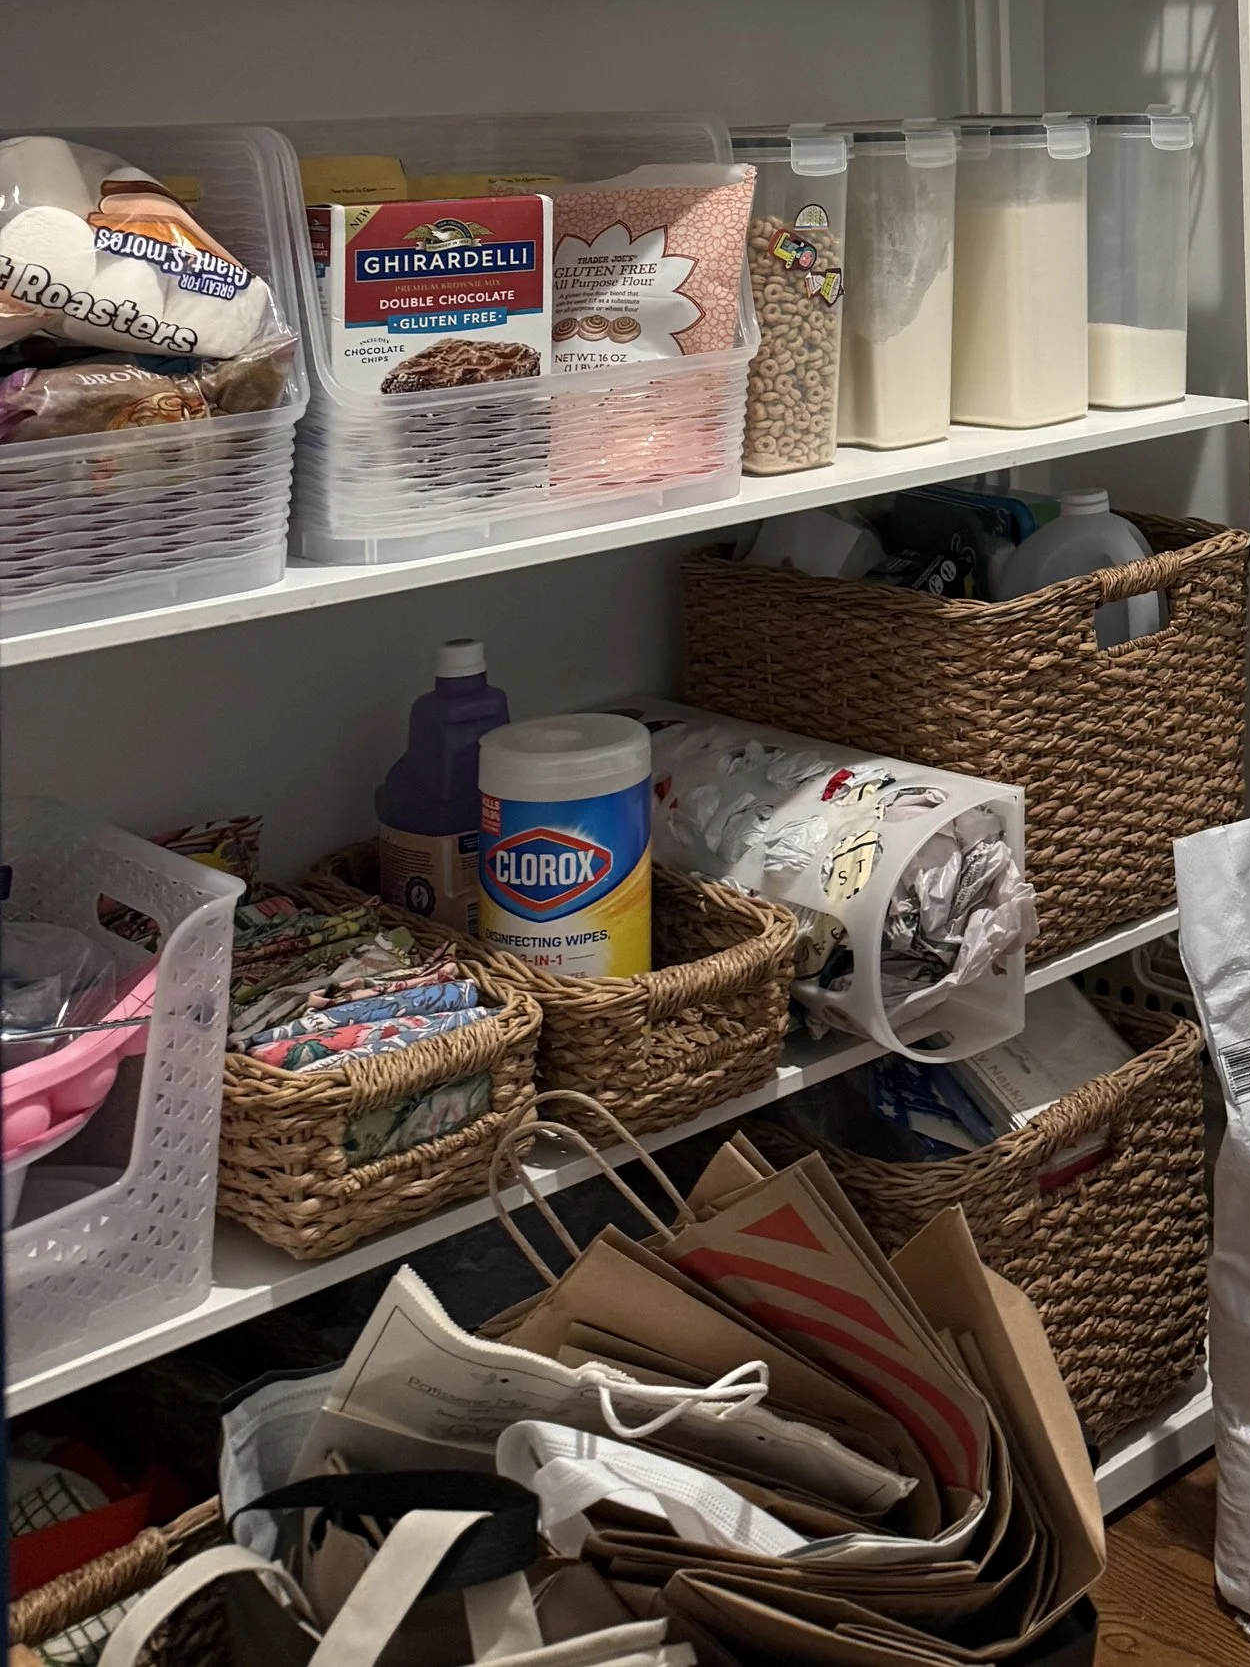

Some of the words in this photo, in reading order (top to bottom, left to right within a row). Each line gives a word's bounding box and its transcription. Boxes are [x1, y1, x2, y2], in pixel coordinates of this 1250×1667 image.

[350, 207, 371, 230] NEW
[364, 248, 527, 274] GHIRARDELLI
[554, 265, 615, 278] GLUTEN
[620, 263, 657, 275] FREE
[571, 278, 618, 290] Purpose
[622, 276, 654, 287] Flour
[12, 264, 198, 353] Roasters
[379, 295, 433, 310] DOUBLE
[439, 290, 515, 305] CHOCOLATE
[400, 314, 457, 329] GLUTEN
[464, 311, 497, 324] FREE
[344, 345, 405, 357] CHOCOLATE
[361, 355, 389, 364] CHIPS
[495, 849, 596, 886] CLOROX
